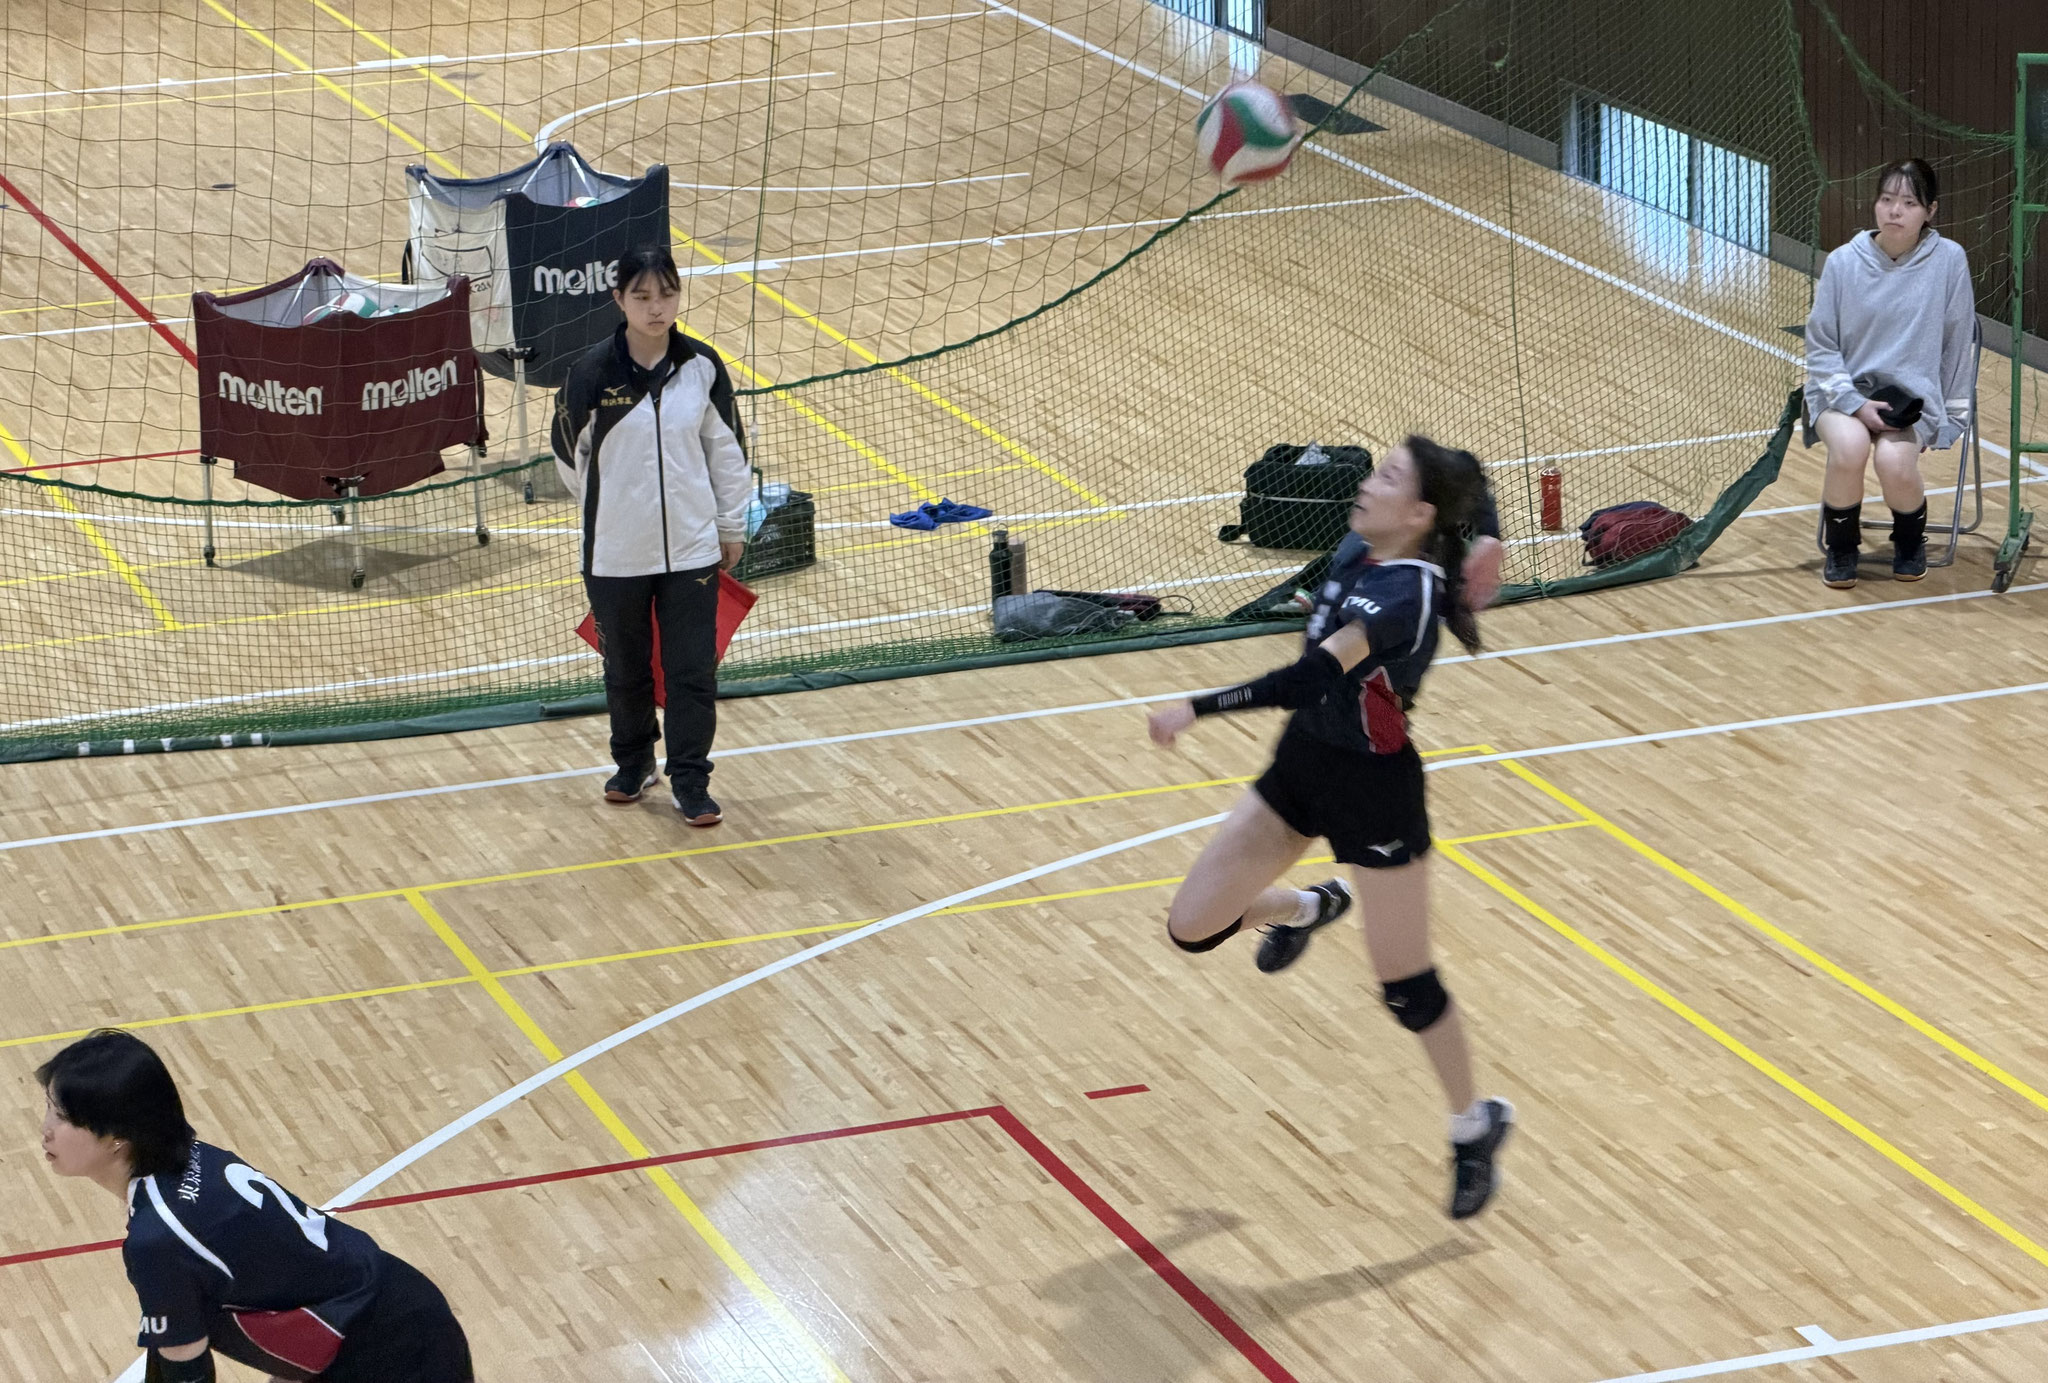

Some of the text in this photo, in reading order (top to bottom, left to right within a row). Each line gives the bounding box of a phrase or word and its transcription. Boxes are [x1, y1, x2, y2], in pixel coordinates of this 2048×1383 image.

[534, 259, 620, 296] molte
[218, 371, 323, 416] molten
[361, 358, 458, 411] molten
[224, 1162, 329, 1252] 2
[139, 1315, 168, 1334] MU
